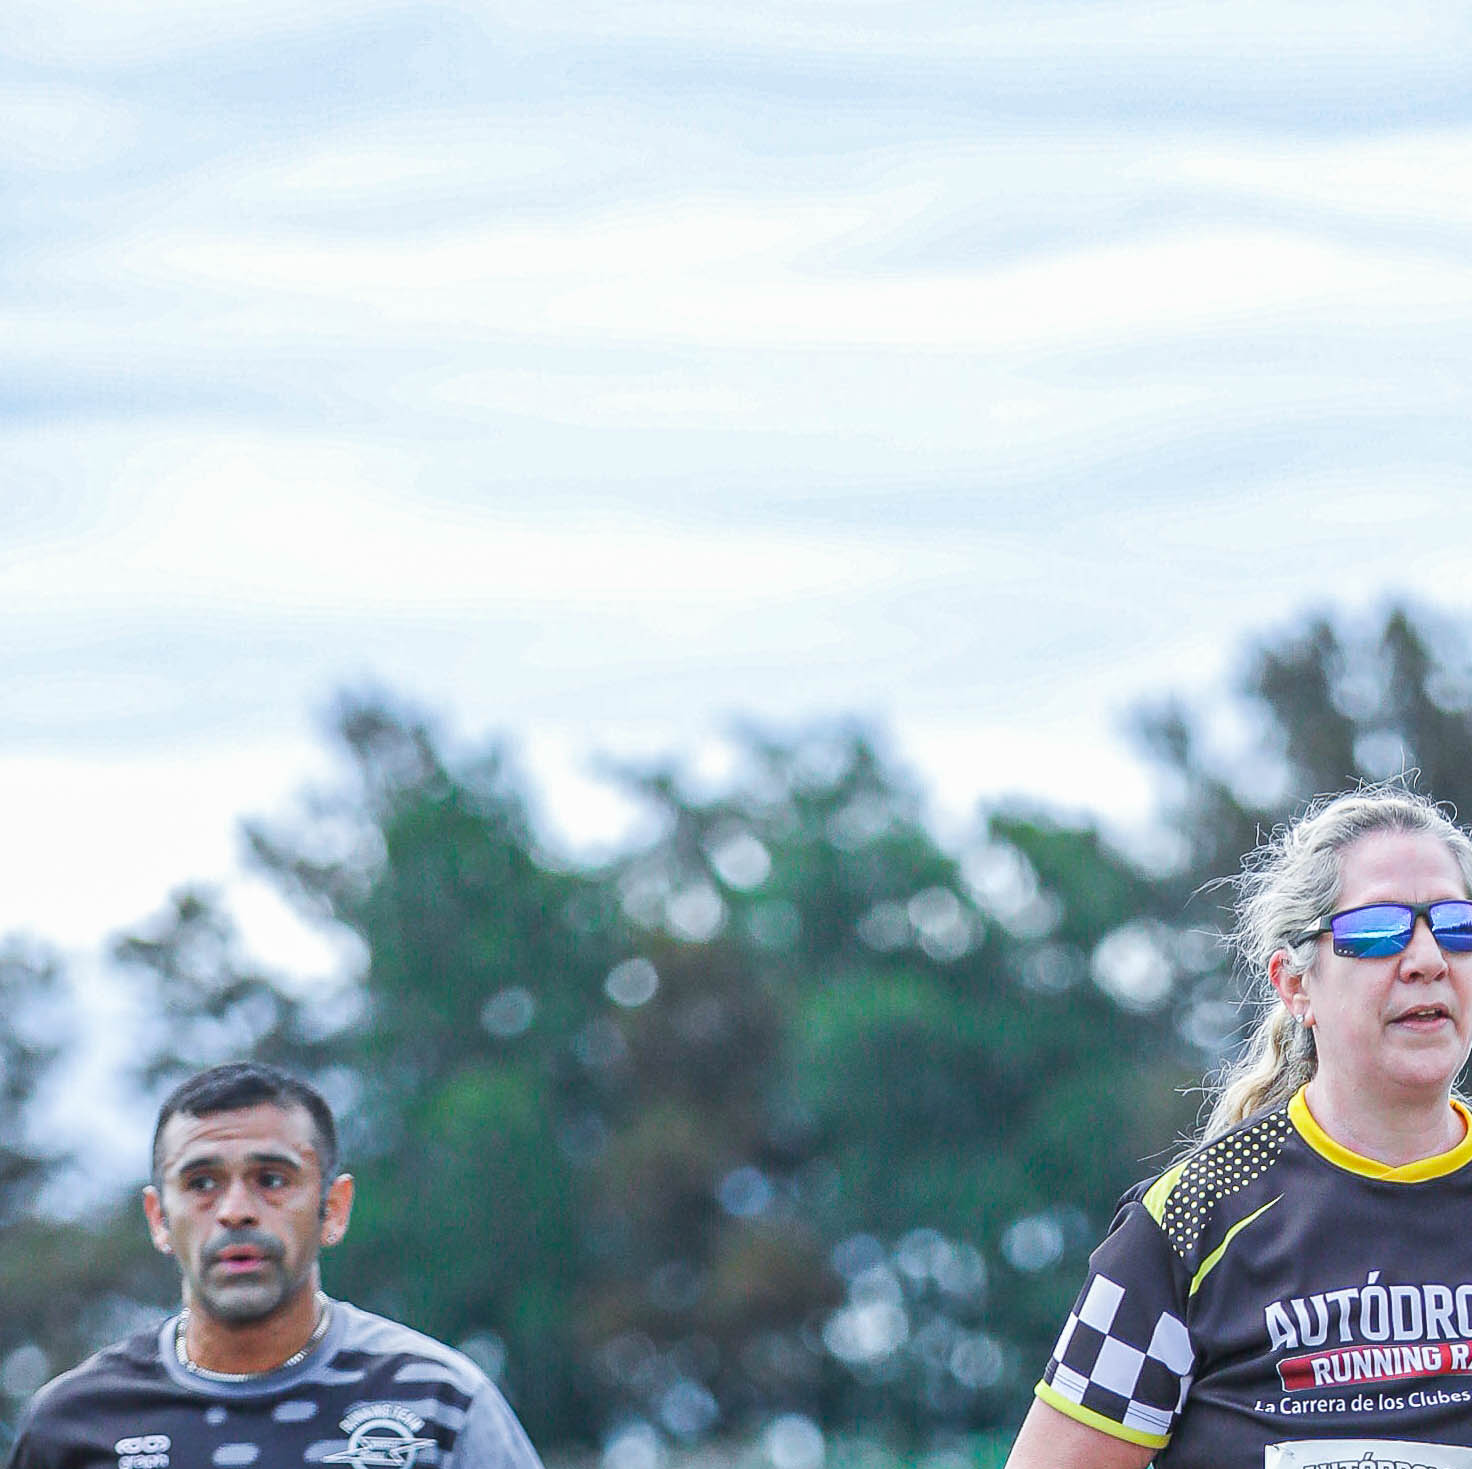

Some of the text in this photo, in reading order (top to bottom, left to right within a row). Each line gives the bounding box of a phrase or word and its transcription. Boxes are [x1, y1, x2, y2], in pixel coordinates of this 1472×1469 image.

[1311, 1346, 1442, 1387] RUNNING
[1254, 1400, 1276, 1413] La
[1280, 1397, 1346, 1415] Carrera
[1350, 1393, 1375, 1412] de
[1378, 1393, 1405, 1411] los
[1408, 1390, 1471, 1408] Clubes
